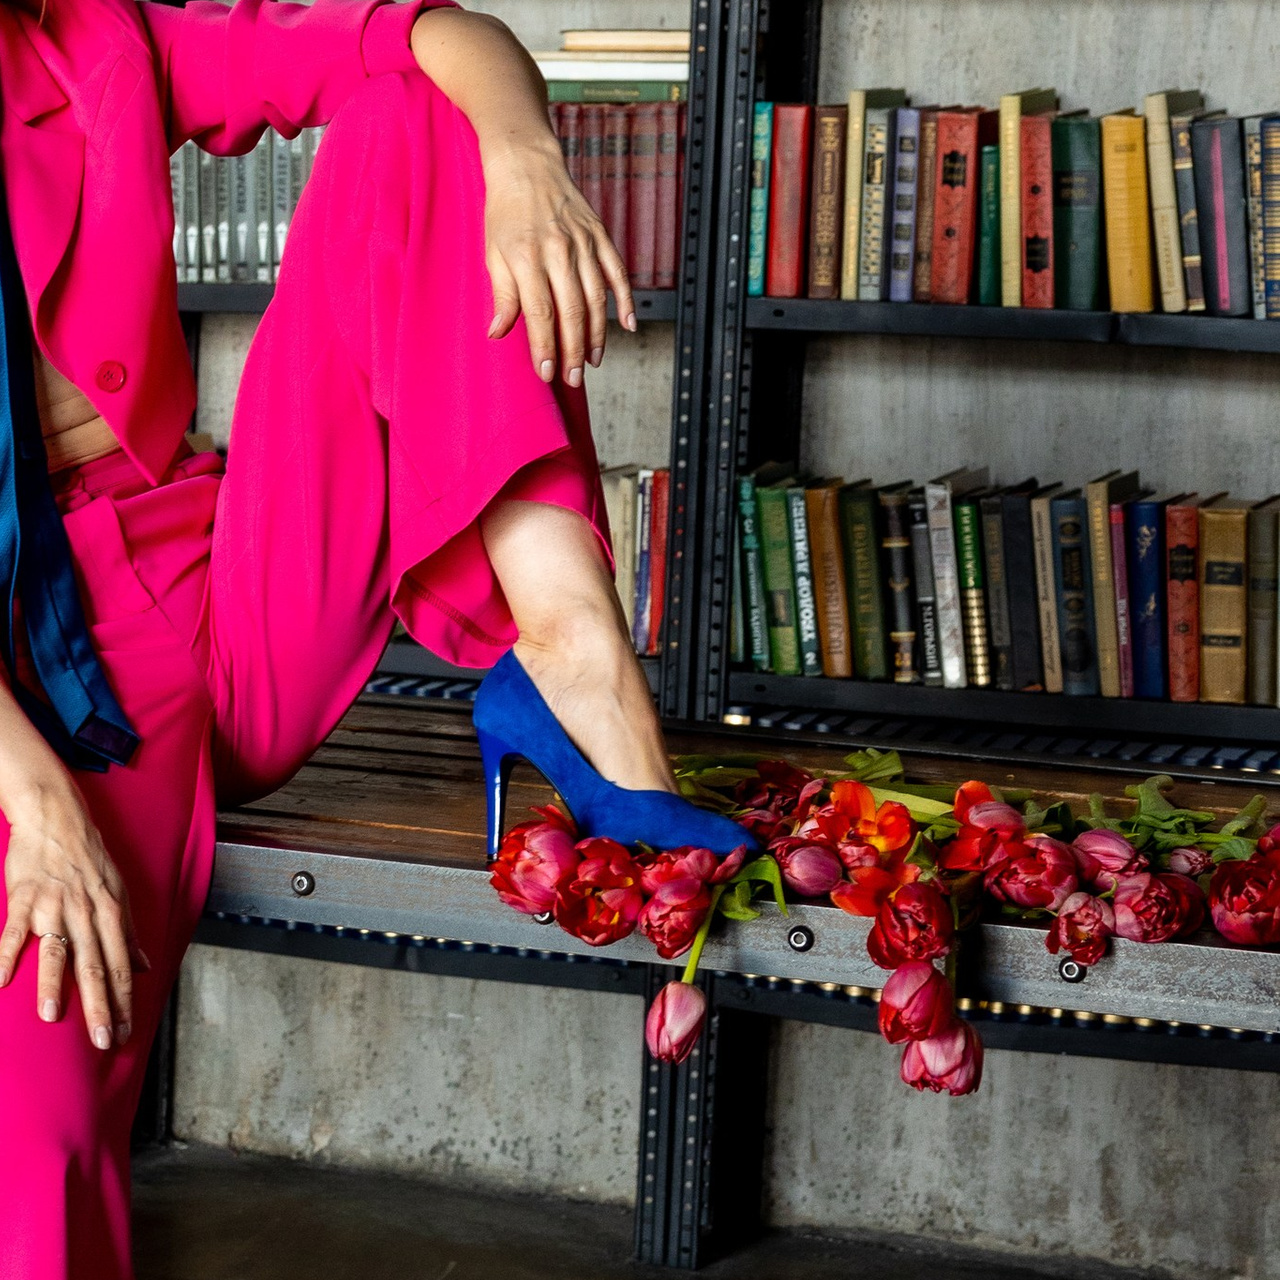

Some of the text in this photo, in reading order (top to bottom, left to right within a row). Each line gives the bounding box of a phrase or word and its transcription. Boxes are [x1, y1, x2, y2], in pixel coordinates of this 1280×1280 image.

[792, 494, 816, 642] ТЕОДОР ДРАЙЗЕР
[805, 652, 816, 666] 2
